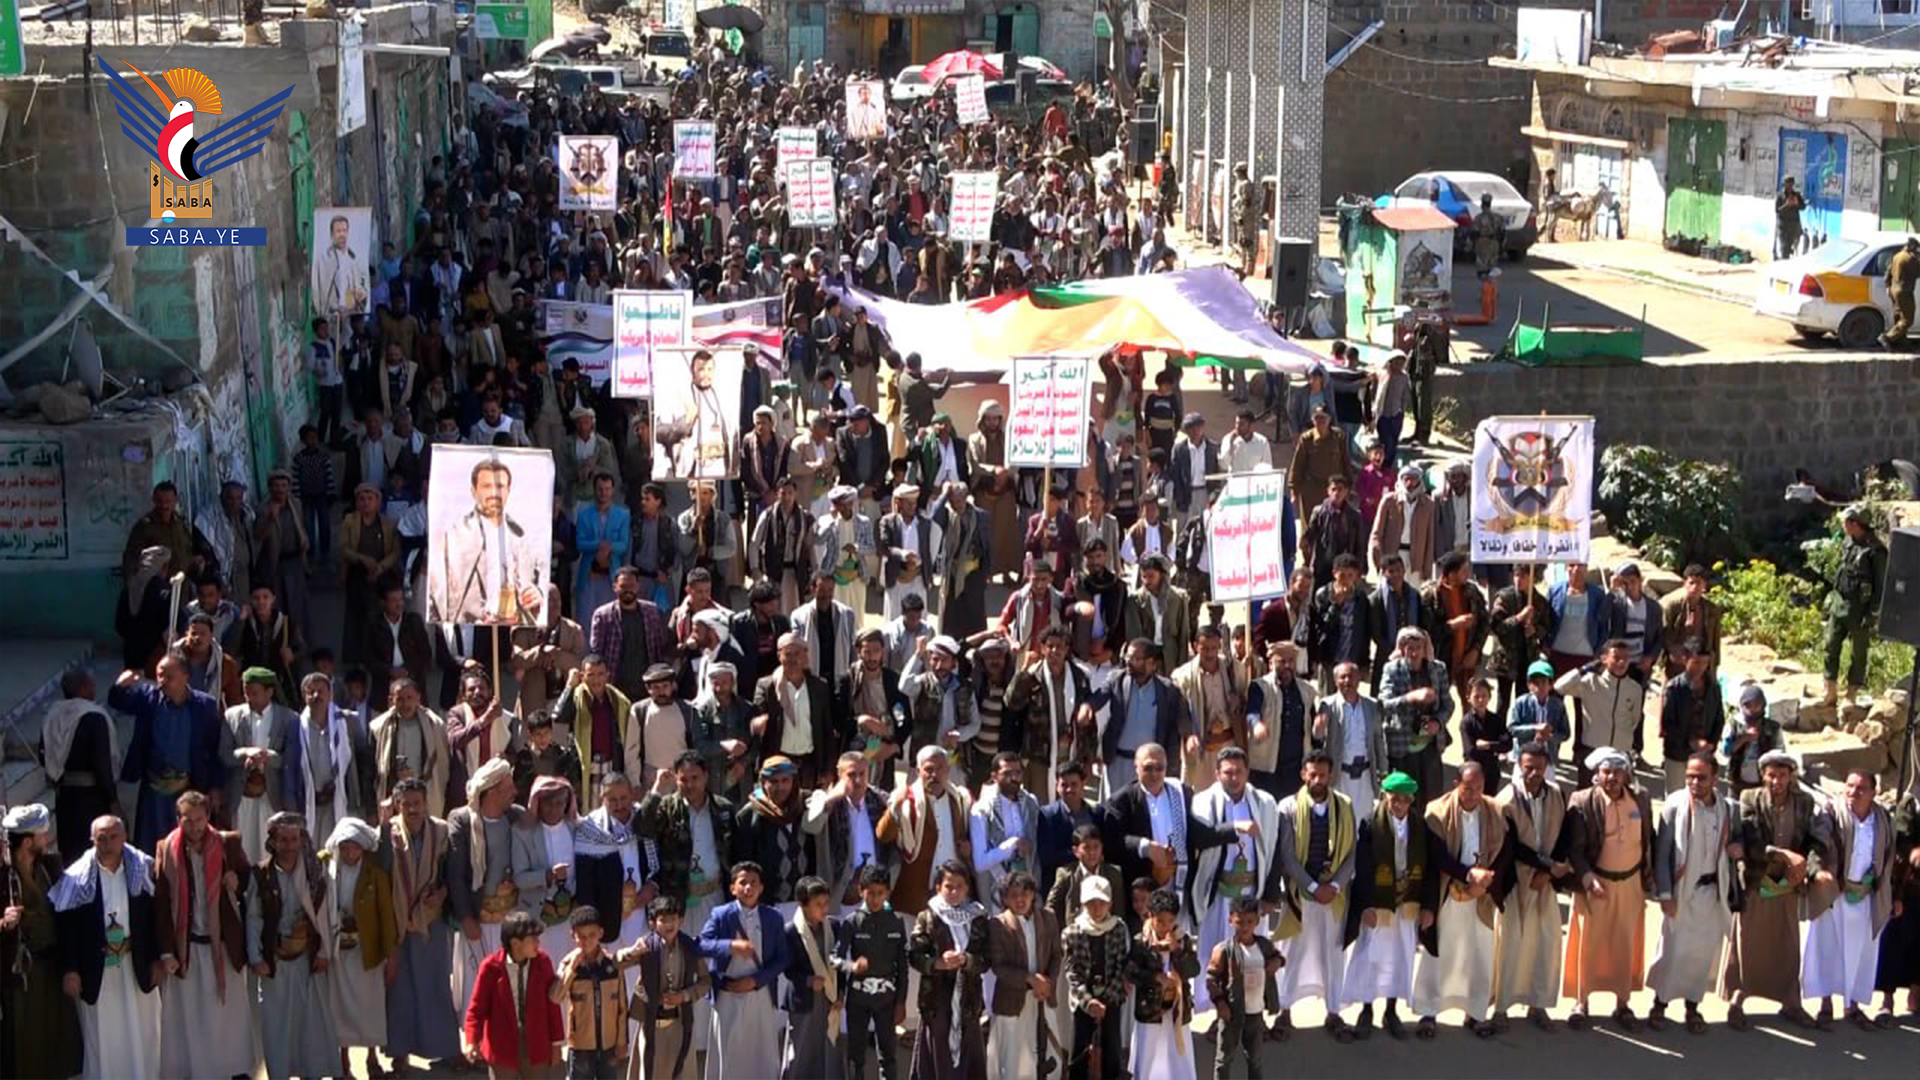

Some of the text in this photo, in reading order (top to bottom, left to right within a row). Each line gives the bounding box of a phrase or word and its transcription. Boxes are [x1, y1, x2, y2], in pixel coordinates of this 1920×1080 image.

[1059, 365, 1084, 379] الله
[1053, 385, 1083, 401] الموت
[1053, 405, 1081, 420] الموت
[1049, 438, 1080, 460] النصر
